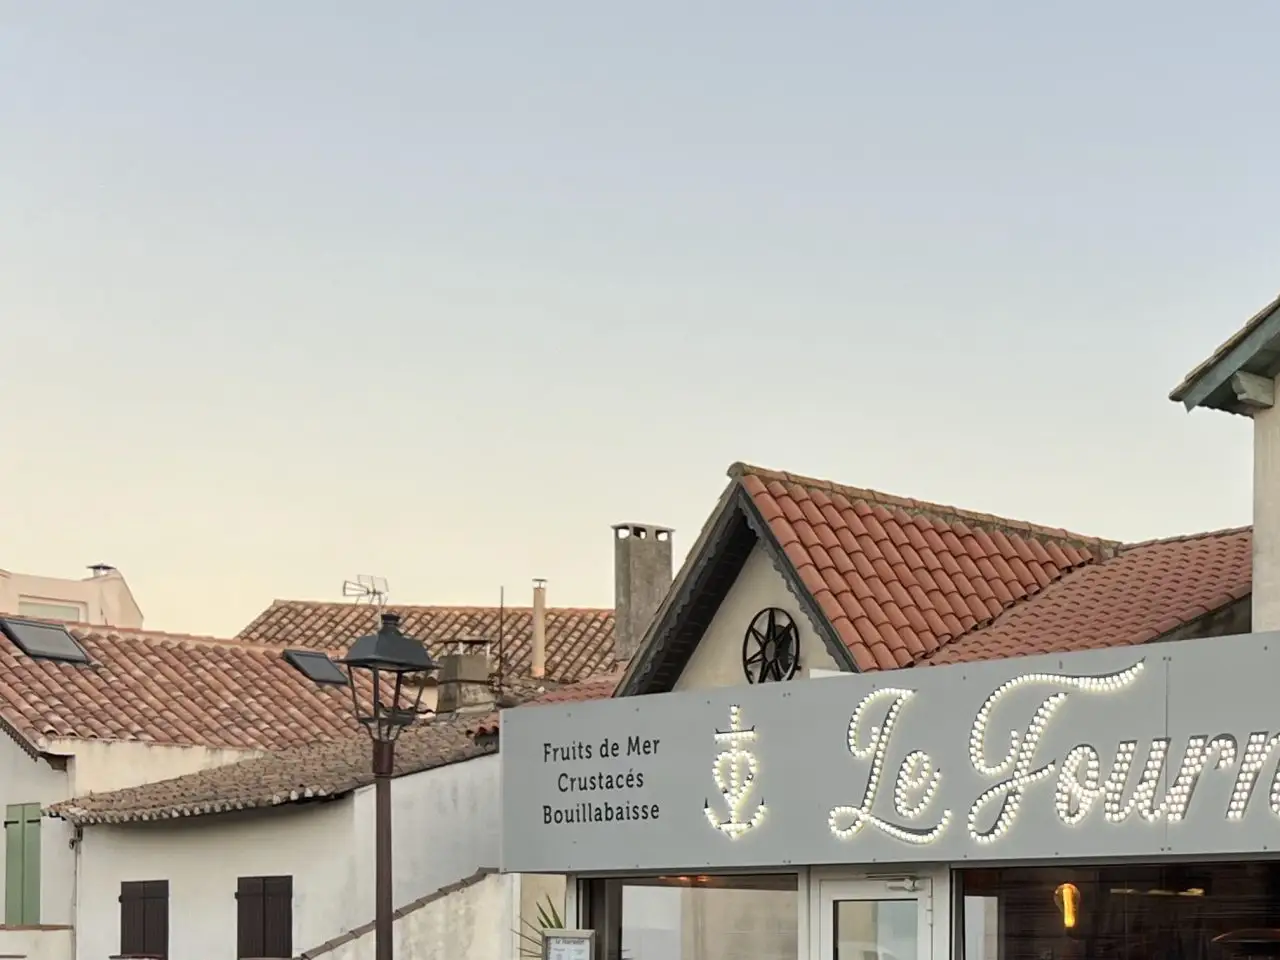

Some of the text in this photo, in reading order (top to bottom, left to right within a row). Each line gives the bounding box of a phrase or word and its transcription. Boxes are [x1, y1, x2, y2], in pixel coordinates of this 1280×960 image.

[543, 735, 660, 763] Fruits de Mer
[829, 687, 952, 845] Le
[557, 767, 645, 793] Crustacés
[542, 800, 660, 825] Bouillabaisse
